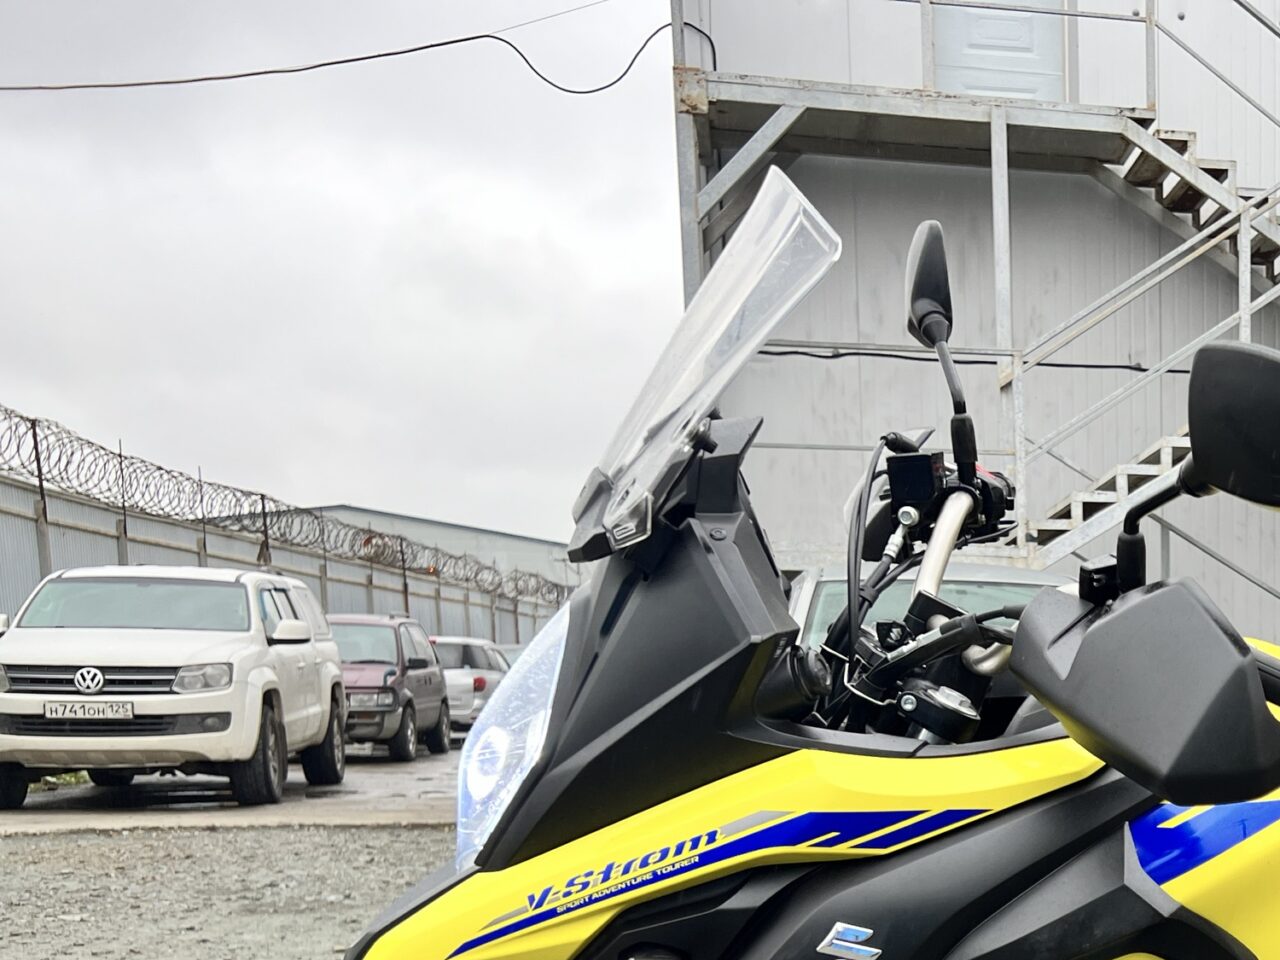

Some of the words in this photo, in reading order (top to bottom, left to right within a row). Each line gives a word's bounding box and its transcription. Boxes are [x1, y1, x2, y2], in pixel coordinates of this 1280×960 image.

[527, 829, 719, 912] V-Strom
[556, 895, 592, 914] SPORT
[591, 872, 654, 900] ADVENTURE
[656, 855, 700, 876] TOURER
